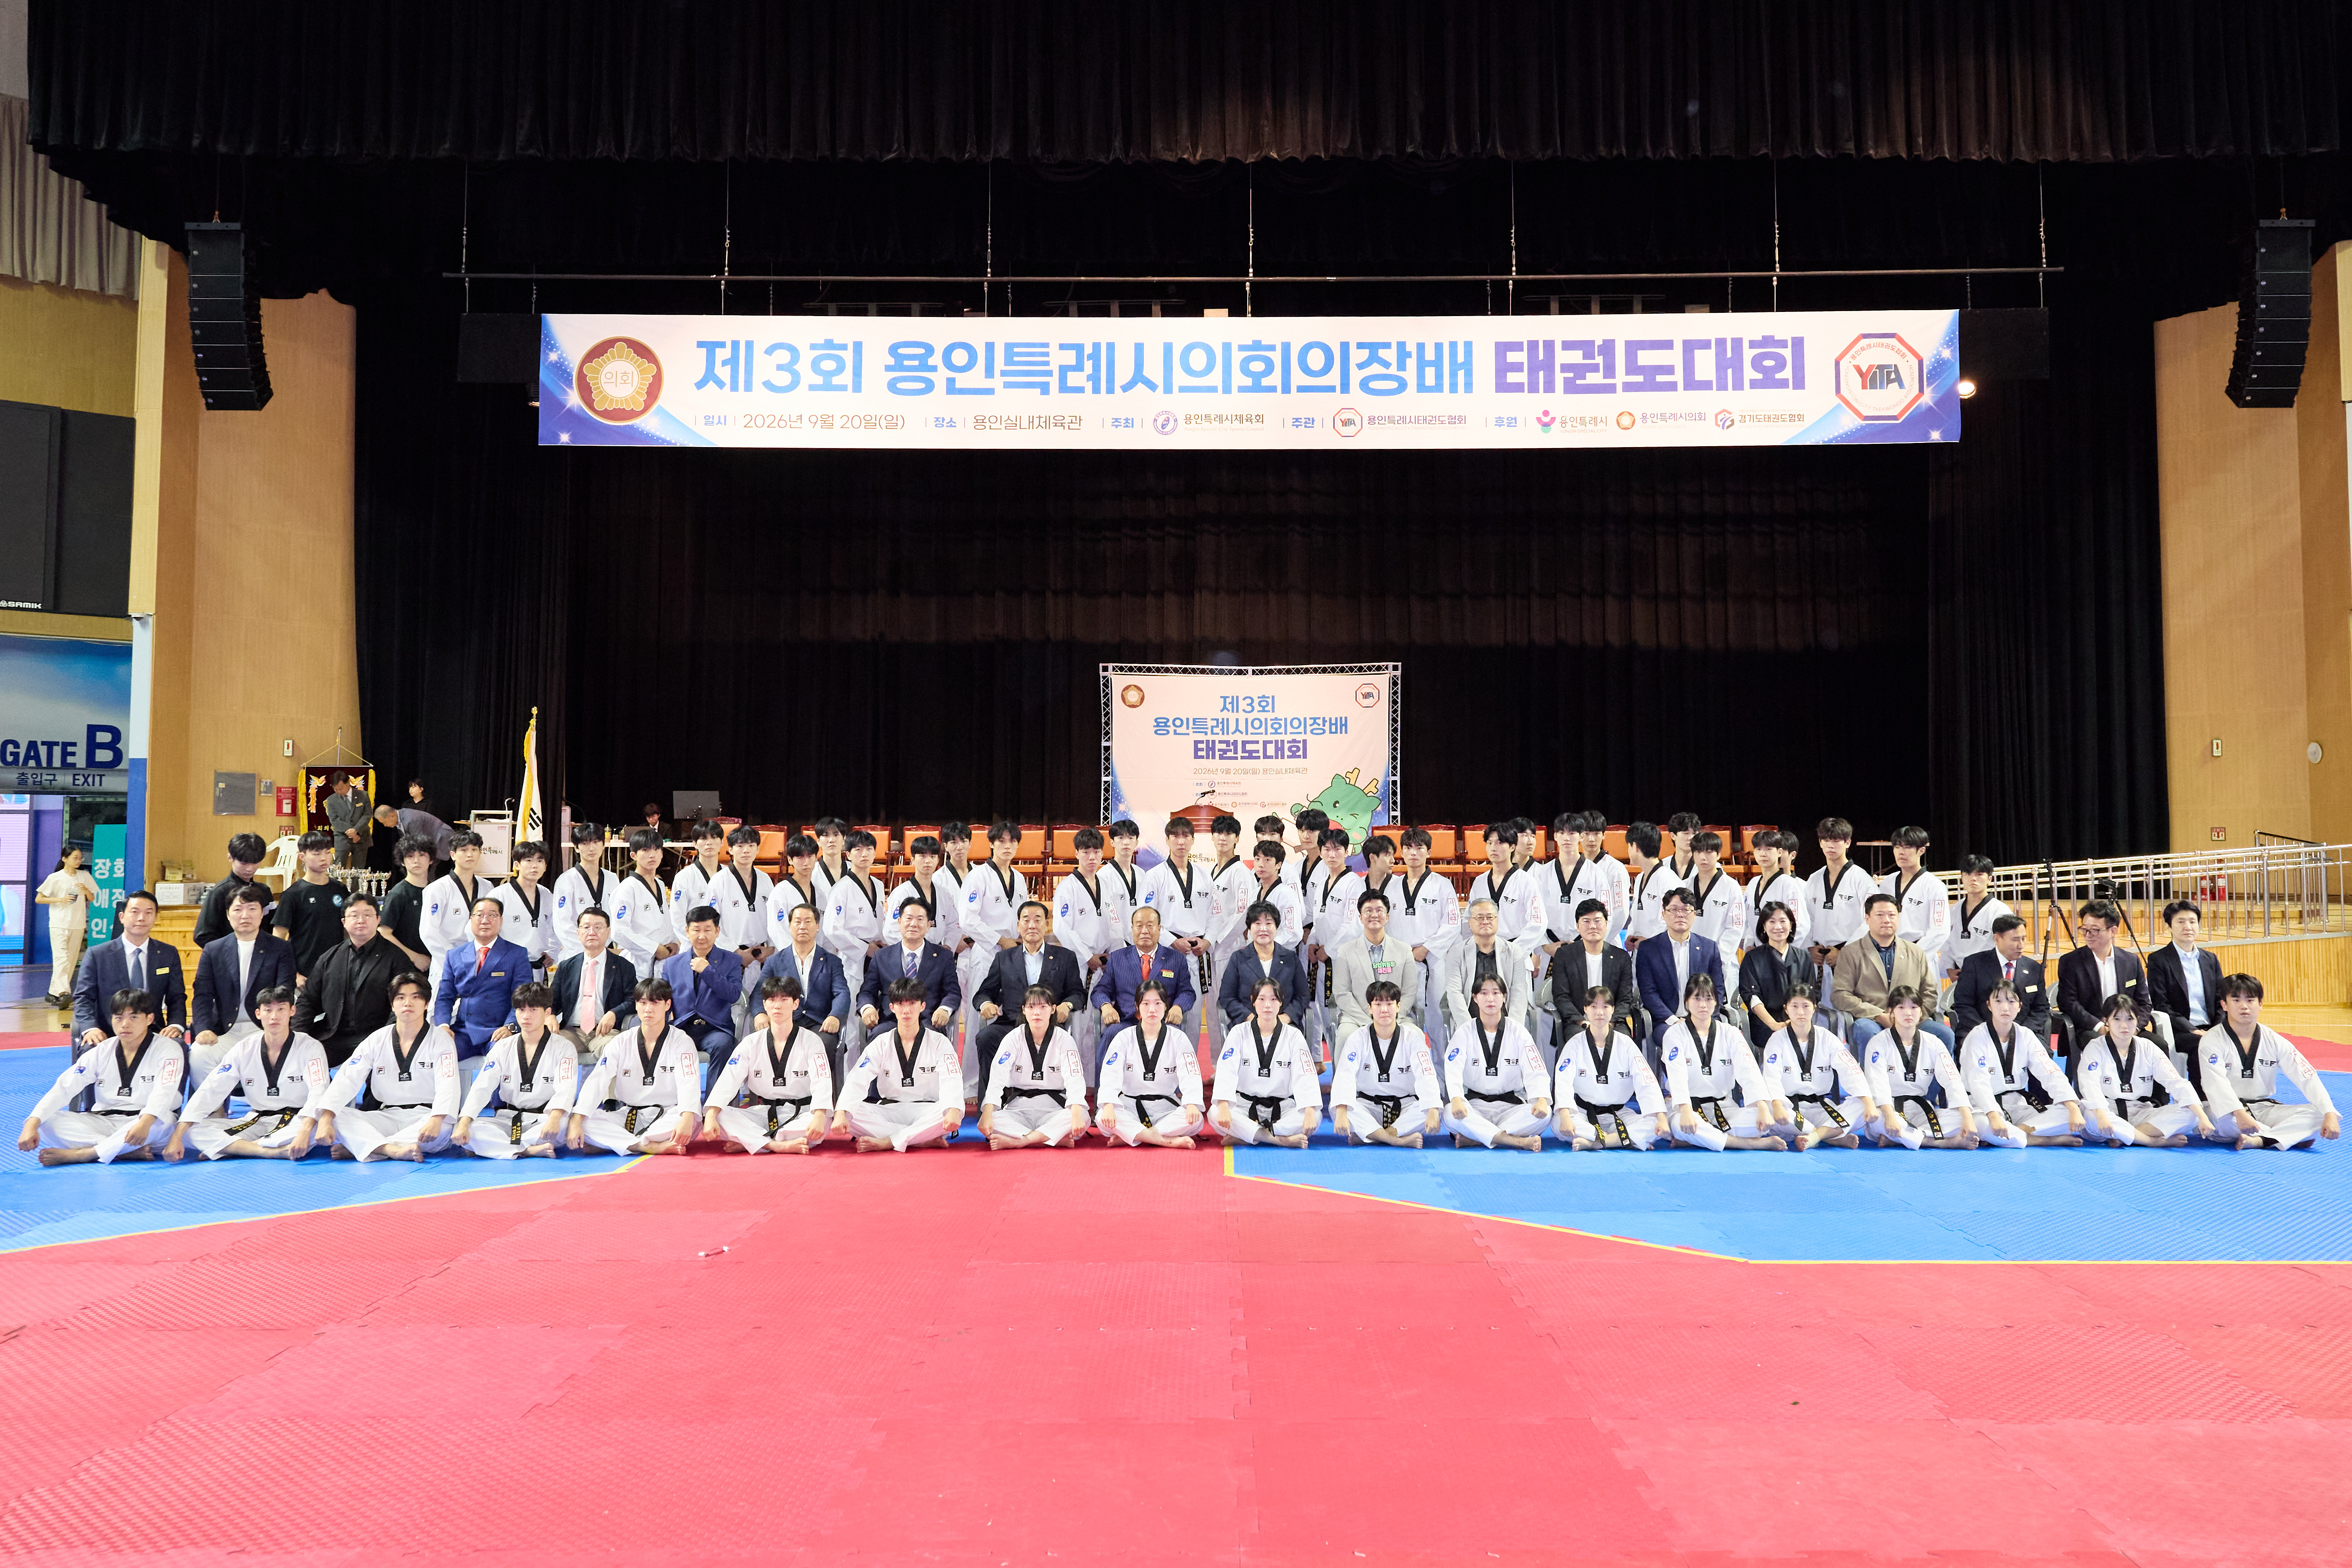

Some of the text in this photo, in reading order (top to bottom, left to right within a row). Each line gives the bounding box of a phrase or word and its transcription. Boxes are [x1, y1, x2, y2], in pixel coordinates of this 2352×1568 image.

[1850, 342, 1907, 361] 용인특례시태권도협회
[694, 336, 1805, 397] 제3회 용인특례시의회의장배 태권도대회
[603, 370, 635, 388] 의회
[1872, 399, 1905, 412] TAEKWONDO
[1904, 364, 1915, 399] ASSOCIATION
[704, 413, 906, 431] 일시 2026년 9월 20일(일)
[933, 415, 1083, 430] 장소 용인실내체육관
[1111, 417, 1134, 429] 주최
[1183, 413, 1264, 424] 용인특례시체육회
[1291, 415, 1466, 429] 주관 용인특례시태권도협회
[1494, 416, 1517, 428] 후원
[1559, 415, 1608, 428] 용인특례시
[1639, 411, 1706, 424] 용인특례시의회
[1738, 413, 1804, 423] 경기도태권도협회
[7, 601, 42, 609] SAMIK
[1220, 694, 1275, 714] 제3회
[1153, 716, 1348, 736] 용인특례시의회의장배
[0, 724, 124, 769] GATE B
[1193, 738, 1307, 760] 태권도대회
[16, 772, 58, 787] 출입구
[72, 773, 106, 787] EXIT
[91, 858, 111, 939] 장애인
[1449, 899, 1457, 924] 시범단
[683, 1054, 695, 1077] 시범단
[815, 1054, 828, 1078] 시범단
[945, 1055, 959, 1075] 시범단
[1070, 1051, 1080, 1076] 시범단
[1186, 1053, 1199, 1075] 시범단
[1302, 1050, 1314, 1075] 시범단
[1421, 1053, 1433, 1075] 시범단
[1528, 1046, 1542, 1071] 시범단
